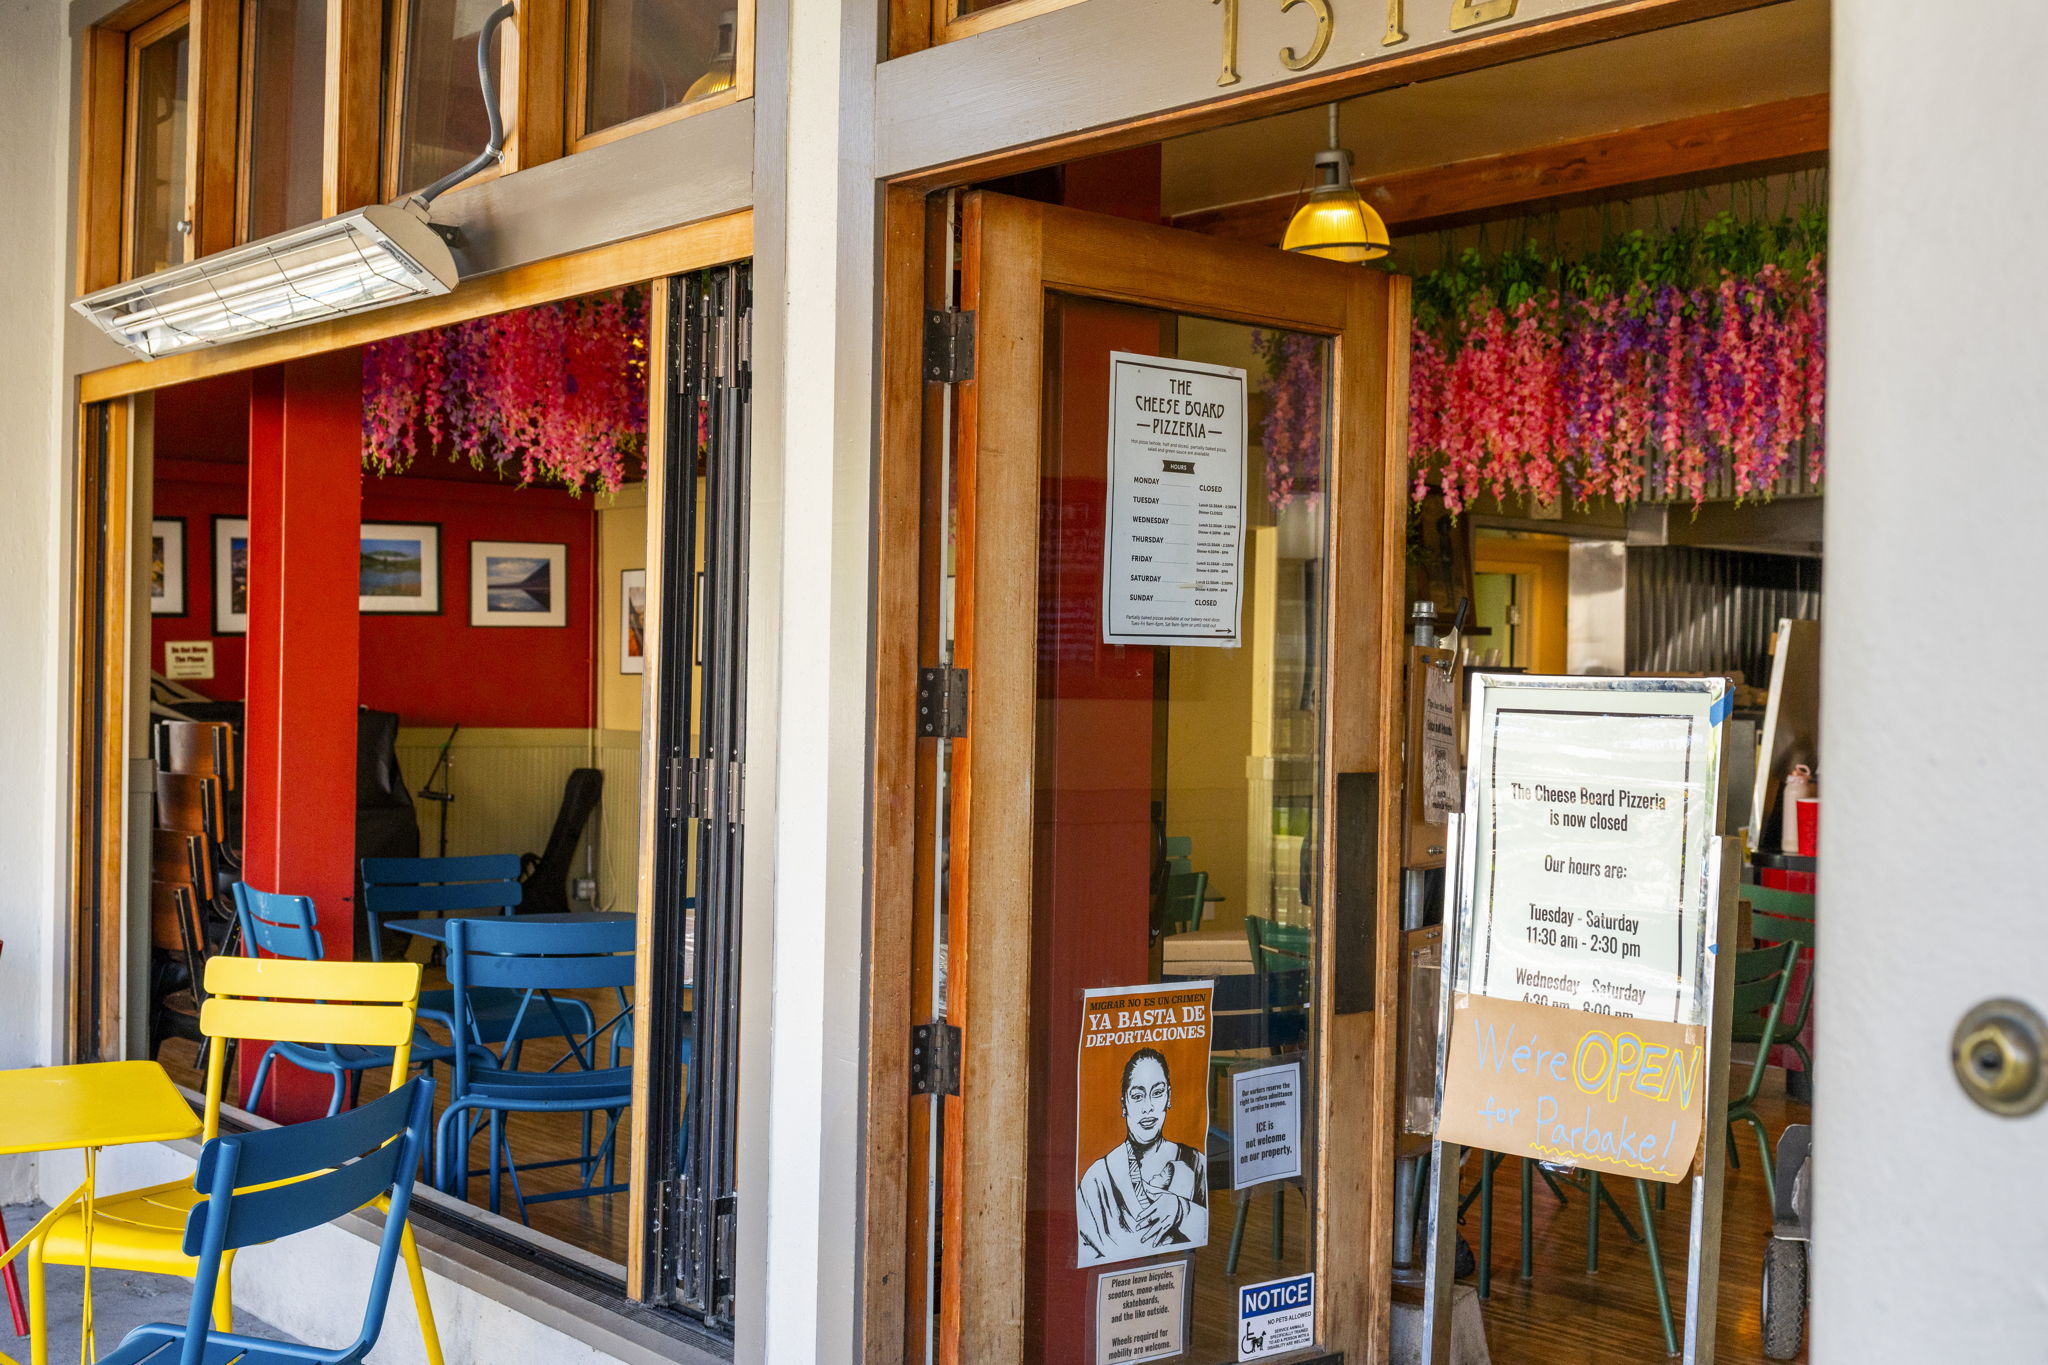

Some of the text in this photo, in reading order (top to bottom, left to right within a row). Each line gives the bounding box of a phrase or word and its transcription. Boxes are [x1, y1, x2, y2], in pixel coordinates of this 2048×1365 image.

[1169, 378, 1193, 396] THE
[1135, 395, 1225, 419] CHEESE BOARD
[1153, 418, 1206, 438] PIZZERIA
[1134, 476, 1222, 492] MONDAY CLOSED
[1133, 496, 1160, 504] TUESDAY
[1132, 516, 1169, 524] WEDNESDAY
[1132, 536, 1164, 544] THURSDAY
[1511, 782, 1666, 811] The Cheese Board Pizzeria
[1550, 809, 1628, 832] is now closed
[1544, 854, 1628, 880] Our hours are:
[1529, 902, 1574, 927] Tuesday
[1586, 910, 1639, 936] Saturday
[1526, 926, 1557, 946] 11:30
[1560, 934, 1578, 949] am
[1590, 934, 1618, 954] 2:30
[1622, 942, 1641, 959] pm
[1516, 967, 1646, 1006] Wednesday Saturday
[1090, 1001, 1125, 1010] MIGRAR
[1128, 998, 1140, 1008] NO
[1144, 998, 1155, 1006] ES
[1158, 996, 1170, 1005] UN
[1089, 1005, 1205, 1031] YA BASTA DE
[1086, 1024, 1205, 1048] DEPORTACIONES
[1474, 1018, 1702, 1111] We're OPEN
[1250, 1087, 1265, 1095] workers
[1268, 1091, 1292, 1100] admittance
[1256, 1121, 1274, 1133] ICE is
[1478, 1095, 1678, 1172] for Parbake!
[1246, 1133, 1286, 1149] not welcome
[1240, 1145, 1292, 1164] on our property.
[1112, 1270, 1174, 1288] Please leave bicycles,
[1108, 1281, 1175, 1300] scooters, mono-wheels,
[1246, 1282, 1308, 1313] NOTICE
[1122, 1295, 1160, 1310] skateboards,
[1111, 1304, 1170, 1324] and the like outside.
[1289, 1311, 1312, 1320] ALLOWED
[1112, 1329, 1168, 1347] Wheels required for
[1108, 1341, 1171, 1360] mobility are welcome.
